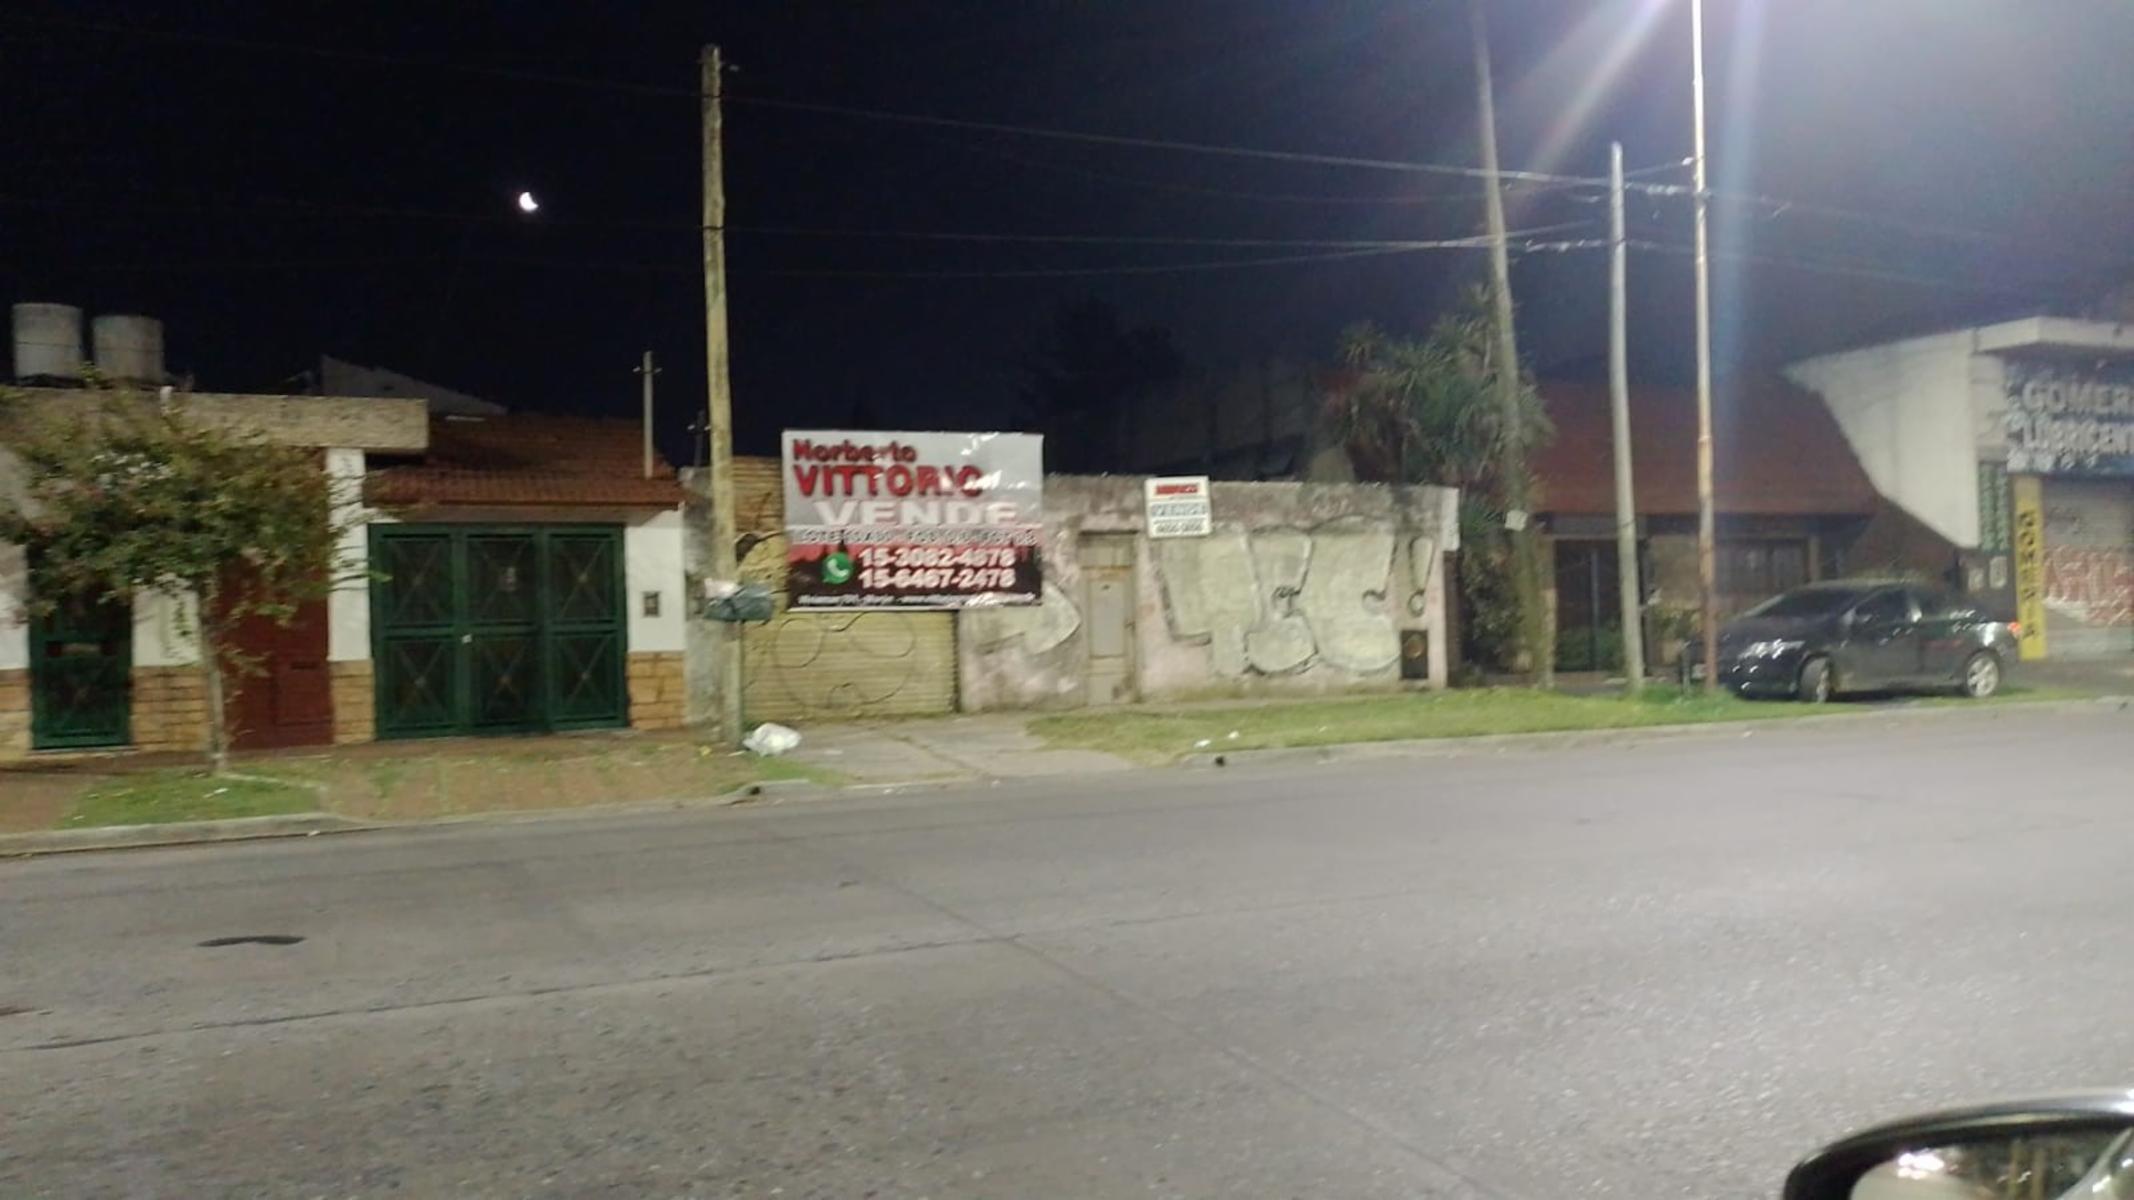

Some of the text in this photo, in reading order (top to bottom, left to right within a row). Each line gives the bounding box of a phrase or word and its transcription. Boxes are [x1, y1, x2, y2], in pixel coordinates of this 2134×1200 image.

[793, 439, 917, 463] Norberto
[793, 464, 983, 497] VITTORIO
[813, 501, 1019, 526] VENDE
